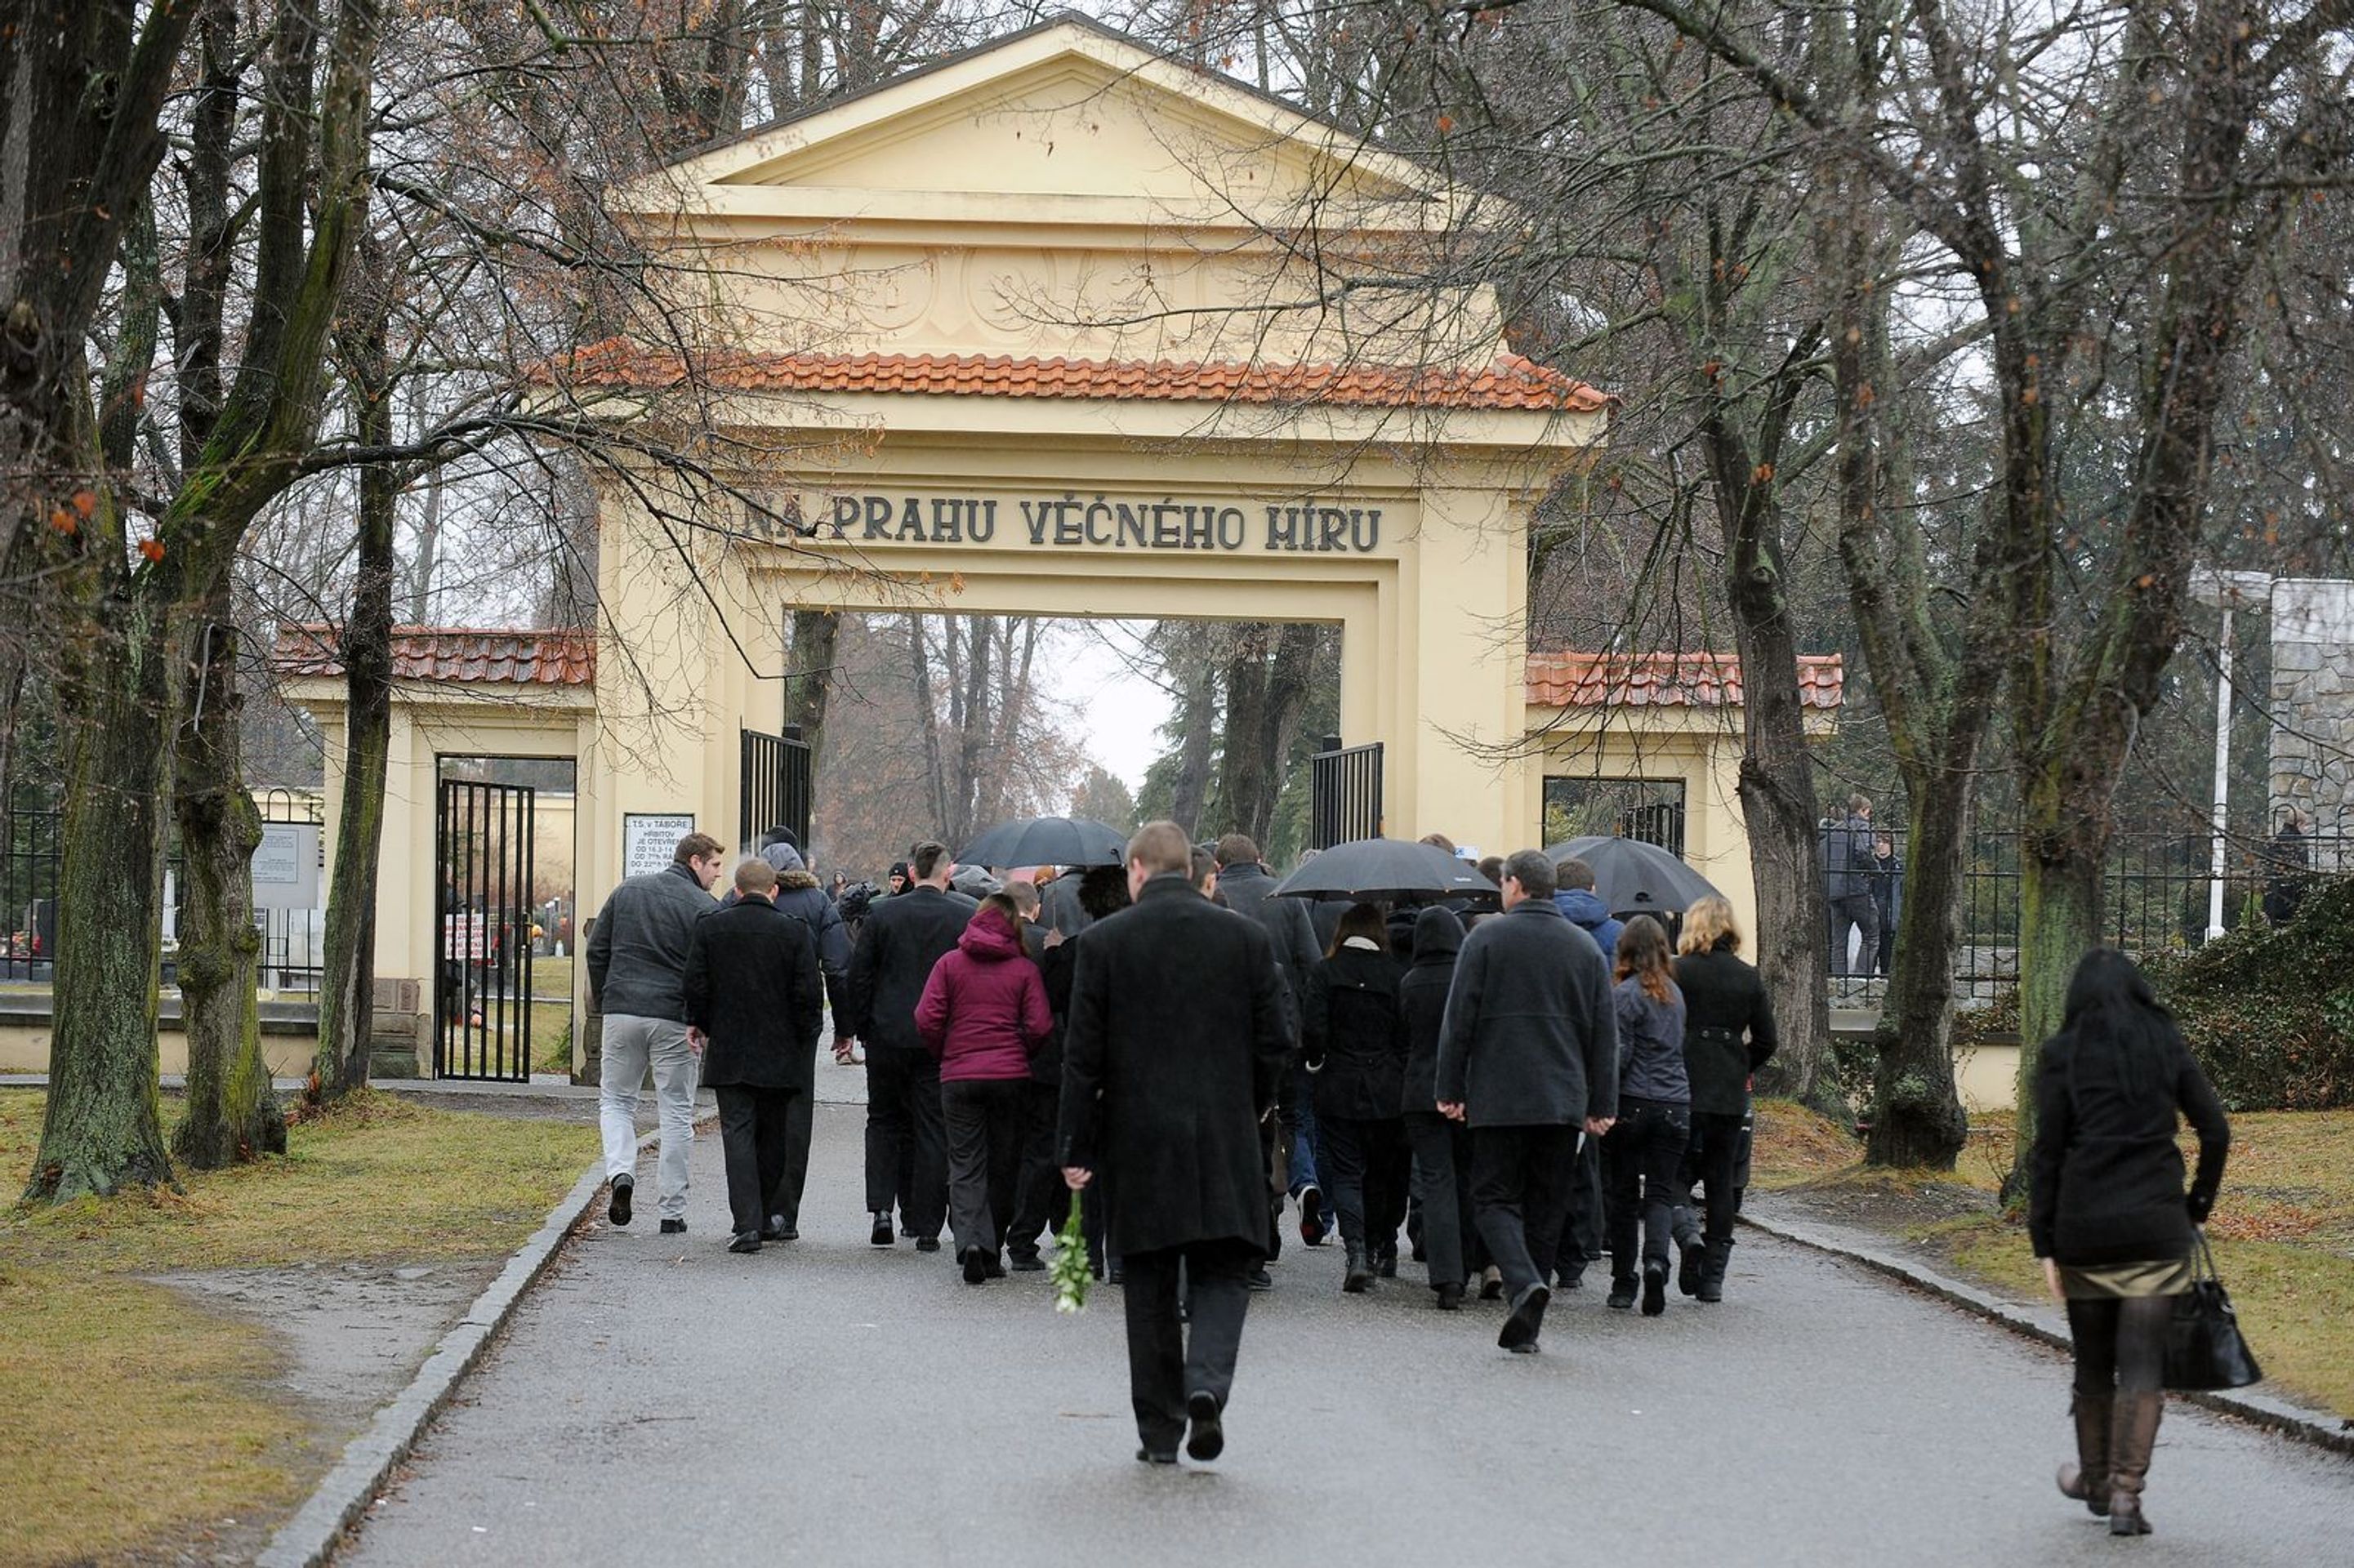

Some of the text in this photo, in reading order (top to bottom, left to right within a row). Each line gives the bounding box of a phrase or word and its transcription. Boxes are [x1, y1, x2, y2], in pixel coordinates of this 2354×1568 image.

[832, 496, 996, 541] PRAHU
[1019, 492, 1245, 550] VĚČNÉHO
[1265, 497, 1381, 552] MÍRU
